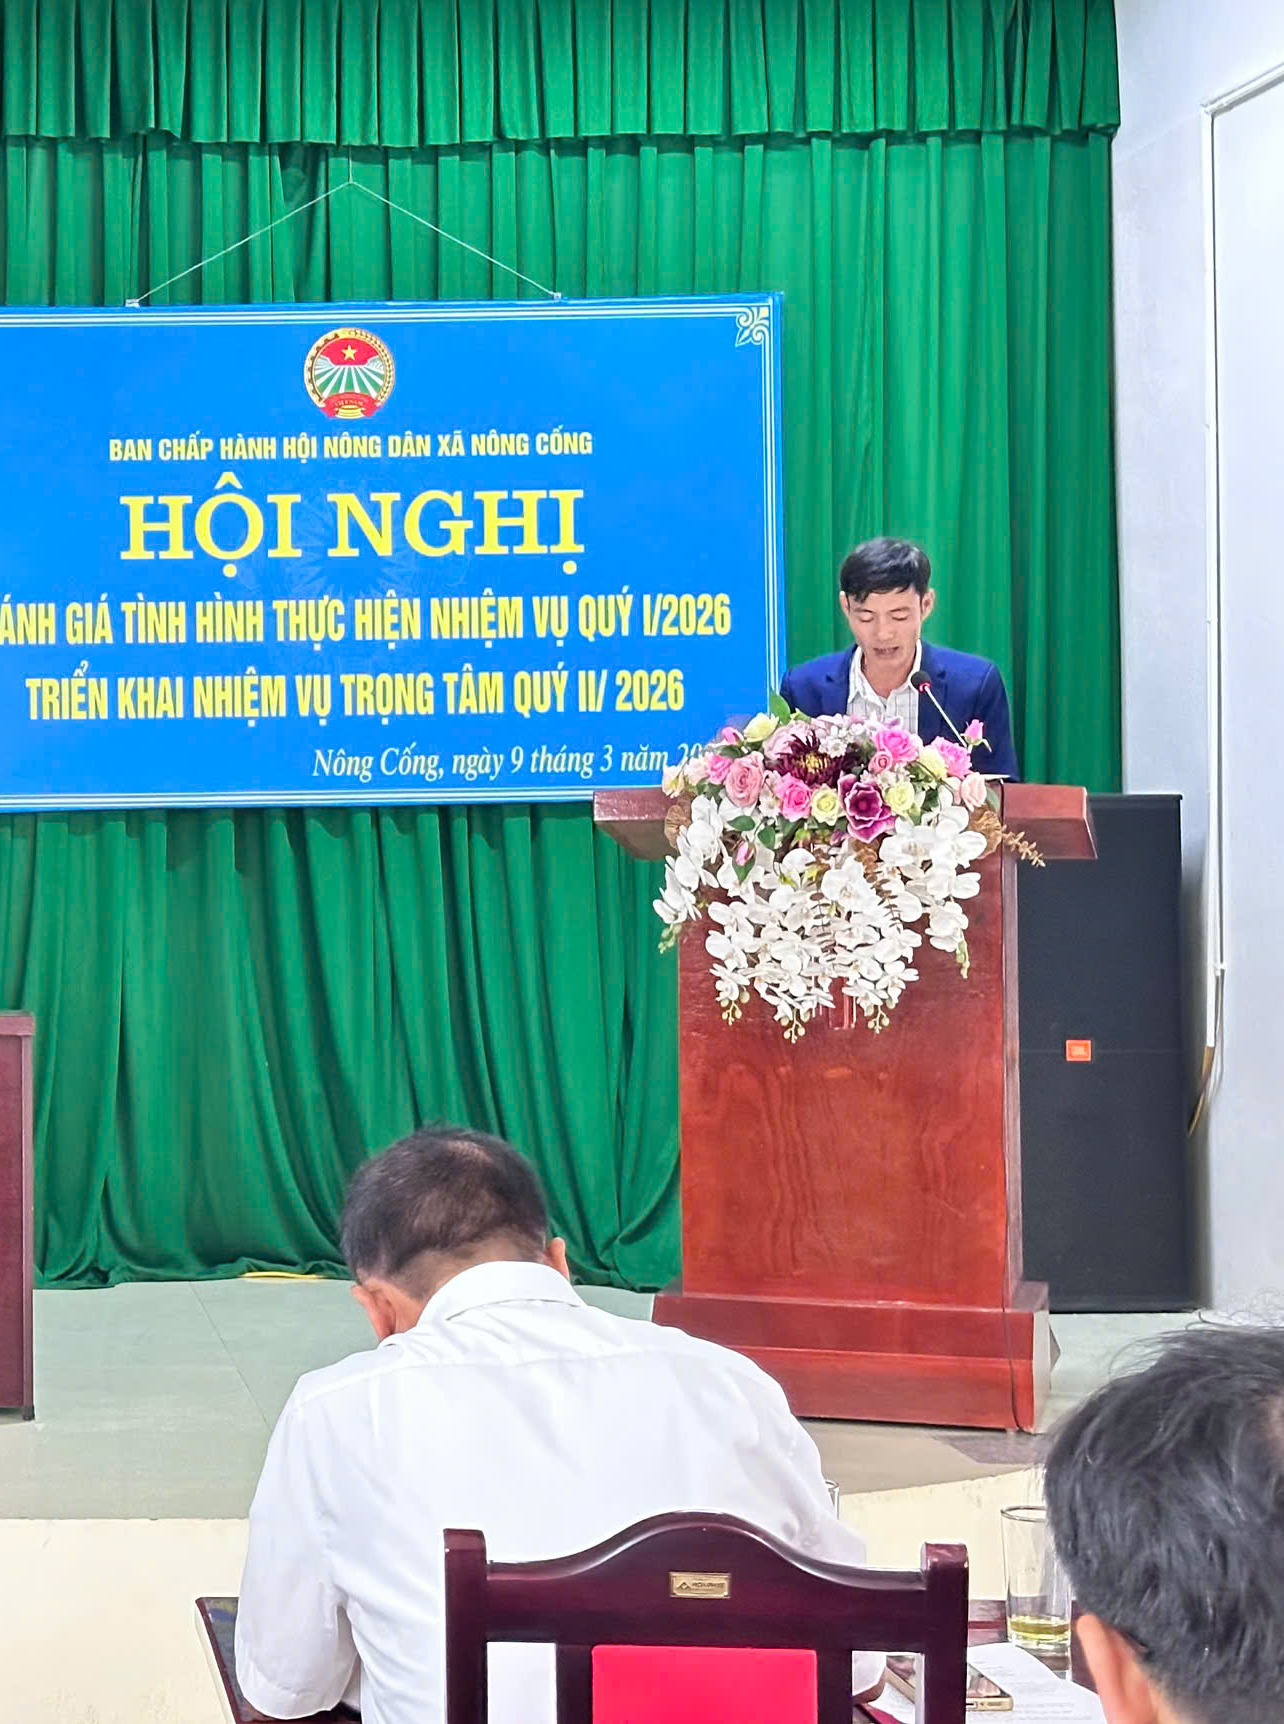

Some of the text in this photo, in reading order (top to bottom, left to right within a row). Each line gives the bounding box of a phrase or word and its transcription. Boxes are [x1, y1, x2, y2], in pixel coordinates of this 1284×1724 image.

[109, 423, 593, 465] BAN CHẤP HÀNH HỘI NÔNG DÂN XÃ NÔNG CỐNG
[119, 471, 585, 578] HỘI NGHỊ
[65, 593, 114, 645] GIÁ
[120, 592, 187, 644] TÌNH
[195, 591, 264, 643] HÌNH
[271, 594, 346, 651] THỰC
[354, 589, 421, 650] HIỆN
[430, 587, 524, 649] NHIỆM
[532, 595, 569, 647] VỤ
[578, 585, 634, 642] QUÝ
[643, 593, 732, 637] I/2026
[25, 659, 685, 728] TRIỂN KHAI NHIỆM VỤ TRỌNG TÂM QUÝ II/ 2026
[312, 749, 374, 783] Nông
[380, 741, 445, 783] Cống,
[451, 746, 504, 782] ngày
[511, 746, 524, 773] 9
[530, 745, 595, 779] tháng
[600, 744, 613, 772] 3
[620, 744, 668, 772] năm
